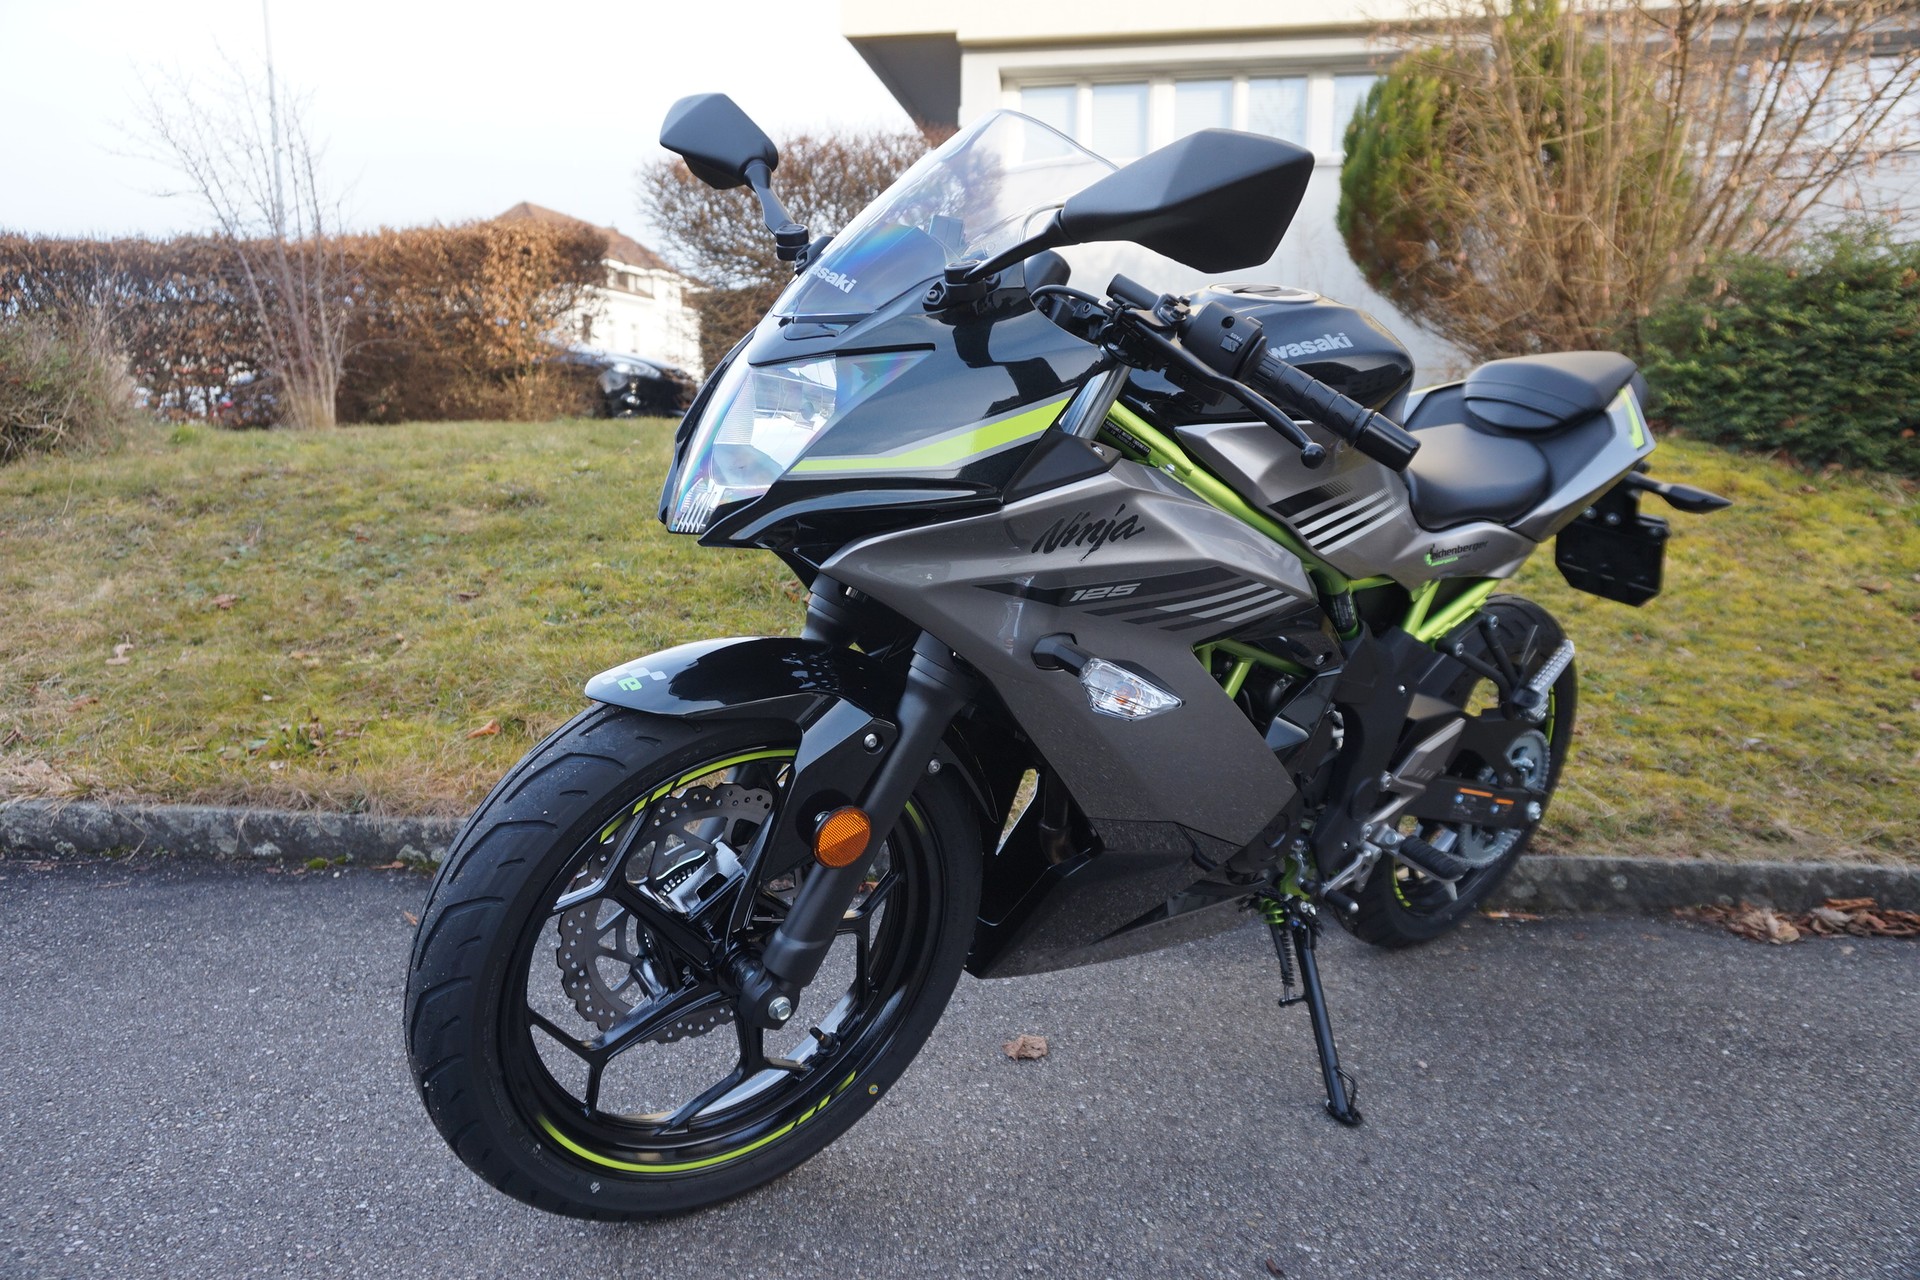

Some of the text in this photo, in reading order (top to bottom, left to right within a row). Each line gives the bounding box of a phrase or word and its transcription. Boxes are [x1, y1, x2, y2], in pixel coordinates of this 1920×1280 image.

[1270, 332, 1354, 359] wasaki
[1031, 503, 1145, 561] Ninja
[1069, 582, 1141, 601] 125
